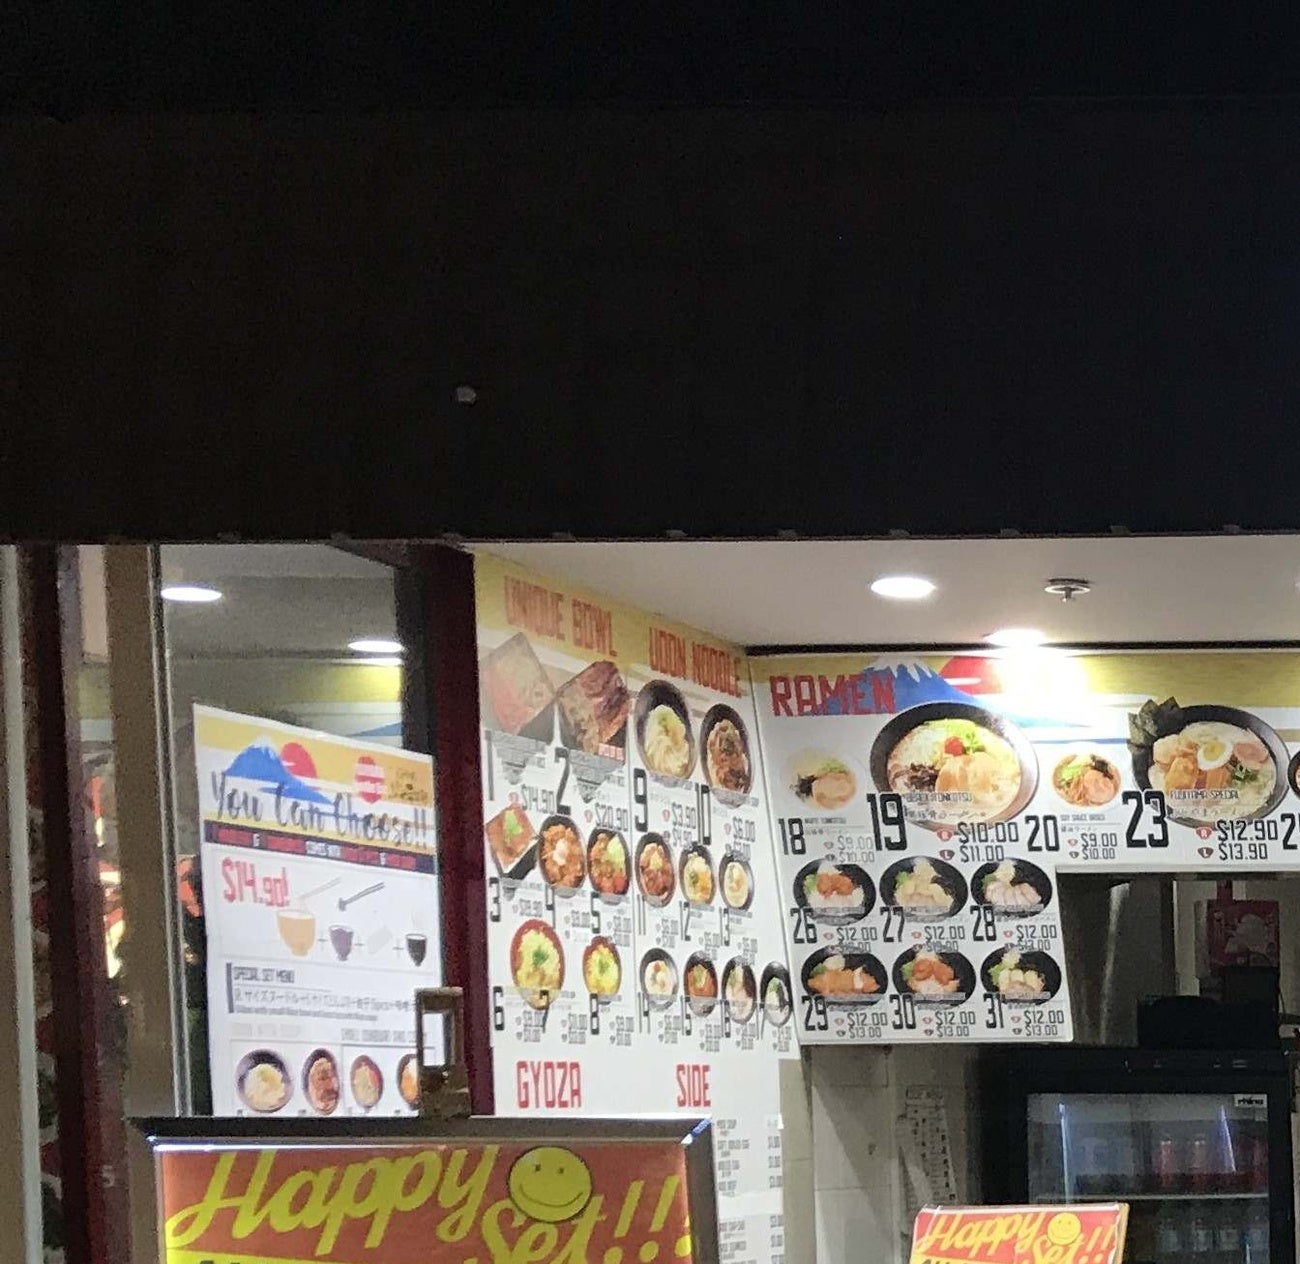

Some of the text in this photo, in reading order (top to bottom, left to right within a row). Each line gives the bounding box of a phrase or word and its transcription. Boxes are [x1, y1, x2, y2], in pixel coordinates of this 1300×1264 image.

[770, 674, 896, 716] RAMEN
[212, 770, 262, 820] You
[634, 768, 648, 832] 9
[779, 818, 806, 855] 18
[867, 793, 908, 851] 19
[958, 822, 1019, 845] $10.00
[1025, 815, 1059, 851] 20
[1122, 790, 1169, 848] 23
[1217, 819, 1278, 844] $12.90
[960, 845, 1005, 864] $11.00
[1219, 843, 1268, 861] $13.90
[791, 907, 817, 943] 26
[836, 926, 878, 942] $12.00
[880, 906, 905, 942] 27
[970, 905, 997, 942] 28
[1016, 924, 1057, 940] $12.00
[801, 995, 828, 1031] 29
[889, 994, 916, 1030] 30
[983, 994, 1004, 1028] 31
[1024, 1010, 1065, 1026] $12.00
[516, 1060, 582, 1109] GYOZA
[676, 1064, 711, 1107] SIDE
[167, 1146, 500, 1258] Happy
[917, 1211, 1047, 1256] Happy
